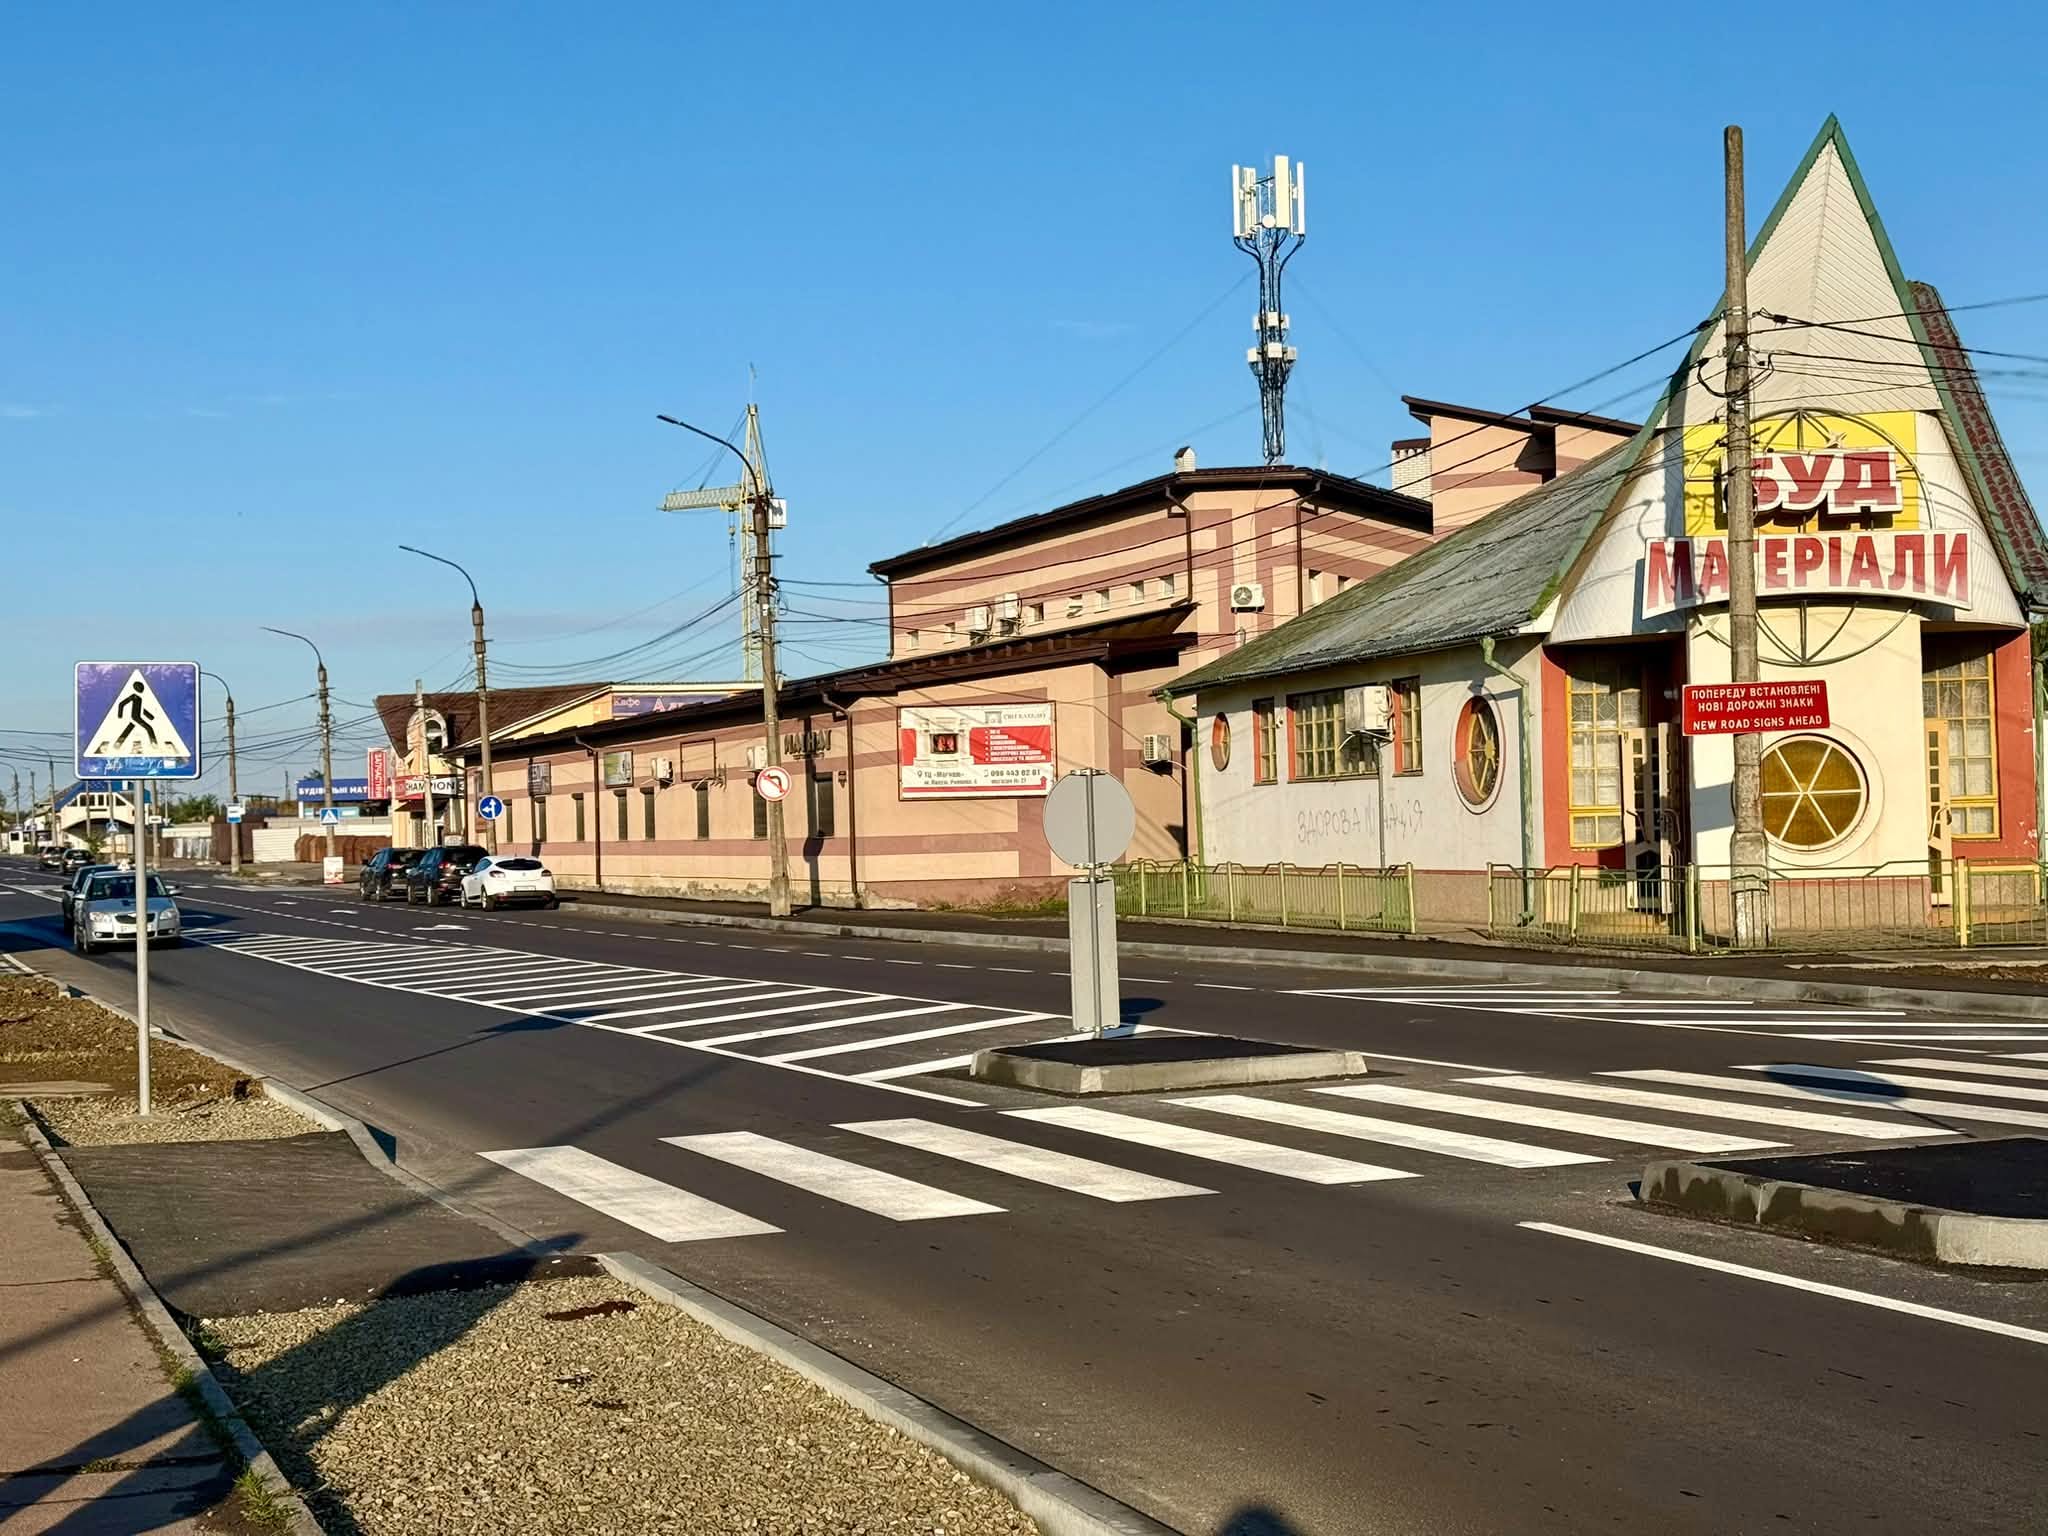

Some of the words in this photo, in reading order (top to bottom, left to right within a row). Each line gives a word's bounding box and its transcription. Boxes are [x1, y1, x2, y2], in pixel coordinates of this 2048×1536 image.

[1748, 451, 1897, 508] БУД
[1646, 533, 1969, 610] МАЕРІАЛИ
[1691, 688, 1746, 699] ПОПЕРЕДУ
[1750, 685, 1820, 697] ВСТАНОВЛЕНІ
[1698, 702, 1723, 712] НОВІ
[1727, 699, 1776, 712] ДОРОЖНІ
[1780, 698, 1814, 708] ЗНАКИ
[1693, 720, 1717, 731] NEW
[1721, 719, 1750, 729] ROAD
[1754, 717, 1785, 728] SIGNS
[1788, 715, 1822, 726] AHEAD
[298, 787, 348, 796] БУДІВЛЬНІ
[405, 780, 456, 793] CHAMION
